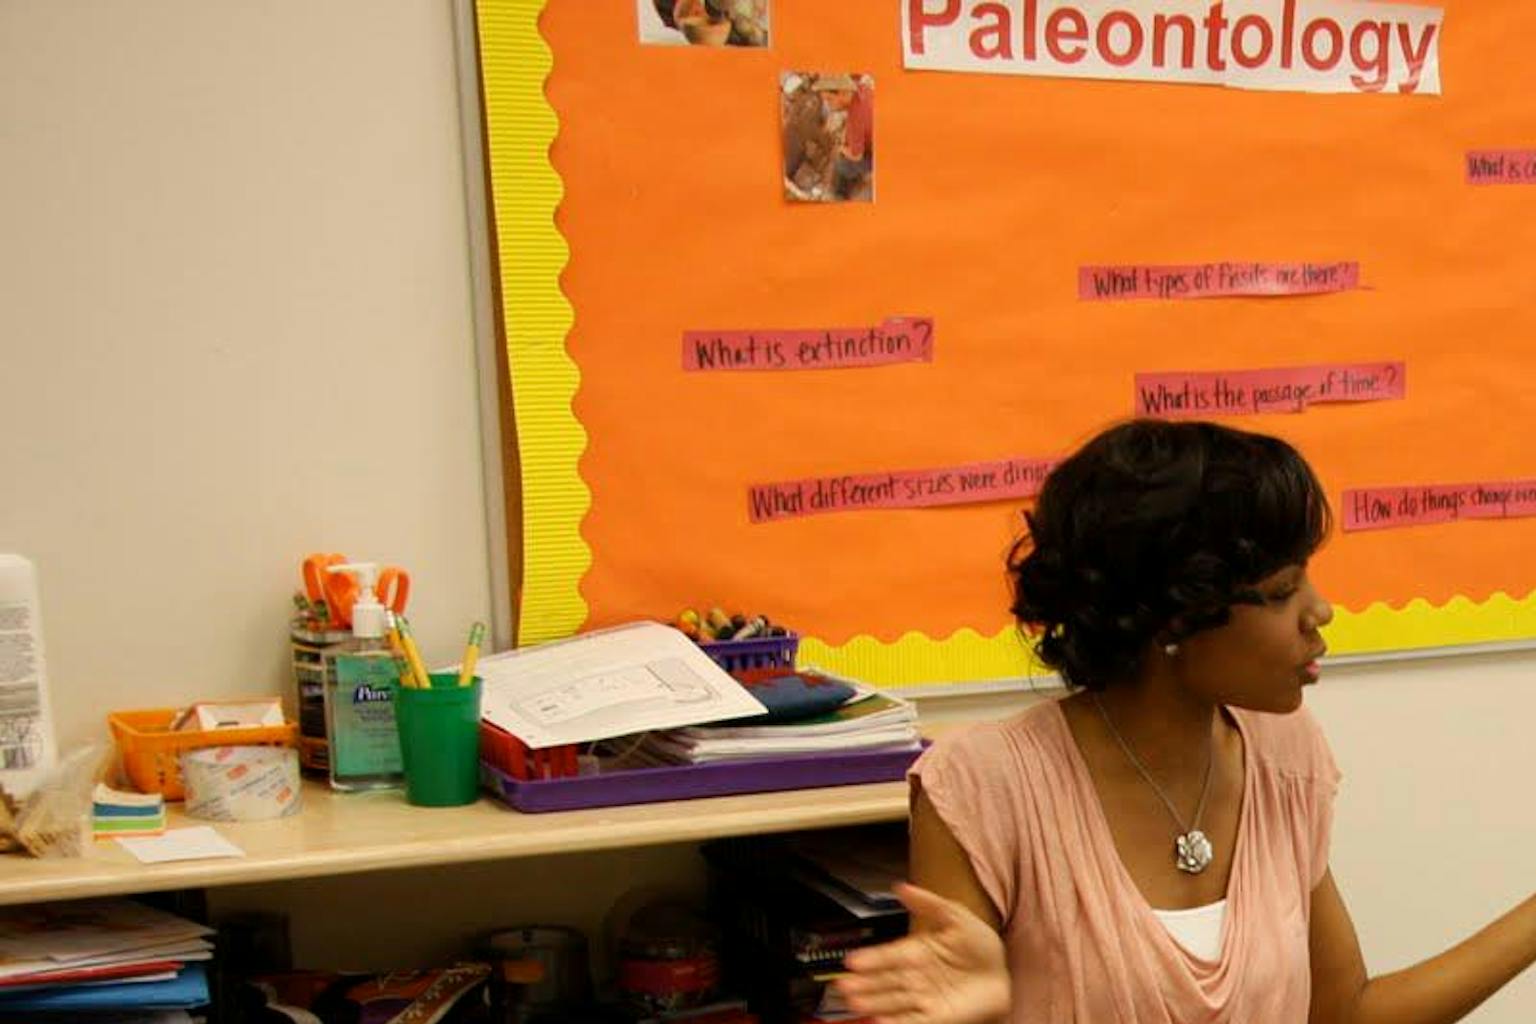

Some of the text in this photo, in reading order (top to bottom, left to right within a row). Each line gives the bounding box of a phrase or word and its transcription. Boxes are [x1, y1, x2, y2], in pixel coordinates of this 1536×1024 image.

[908, 0, 1437, 93] Paleontology
[1469, 154, 1505, 179] What
[1509, 160, 1521, 178] is
[1093, 268, 1137, 296] What
[1146, 268, 1185, 301] types
[1193, 267, 1211, 290] of
[1276, 266, 1298, 285] are
[695, 321, 933, 369] What is extinction?
[1141, 379, 1191, 413] What
[1195, 385, 1209, 409] is
[1214, 376, 1242, 406] the
[750, 482, 803, 519] What
[810, 474, 896, 509] different
[904, 475, 954, 499] sizes
[960, 470, 997, 492] were
[1354, 491, 1392, 522] How
[1397, 493, 1418, 517] do
[1422, 488, 1465, 519] things
